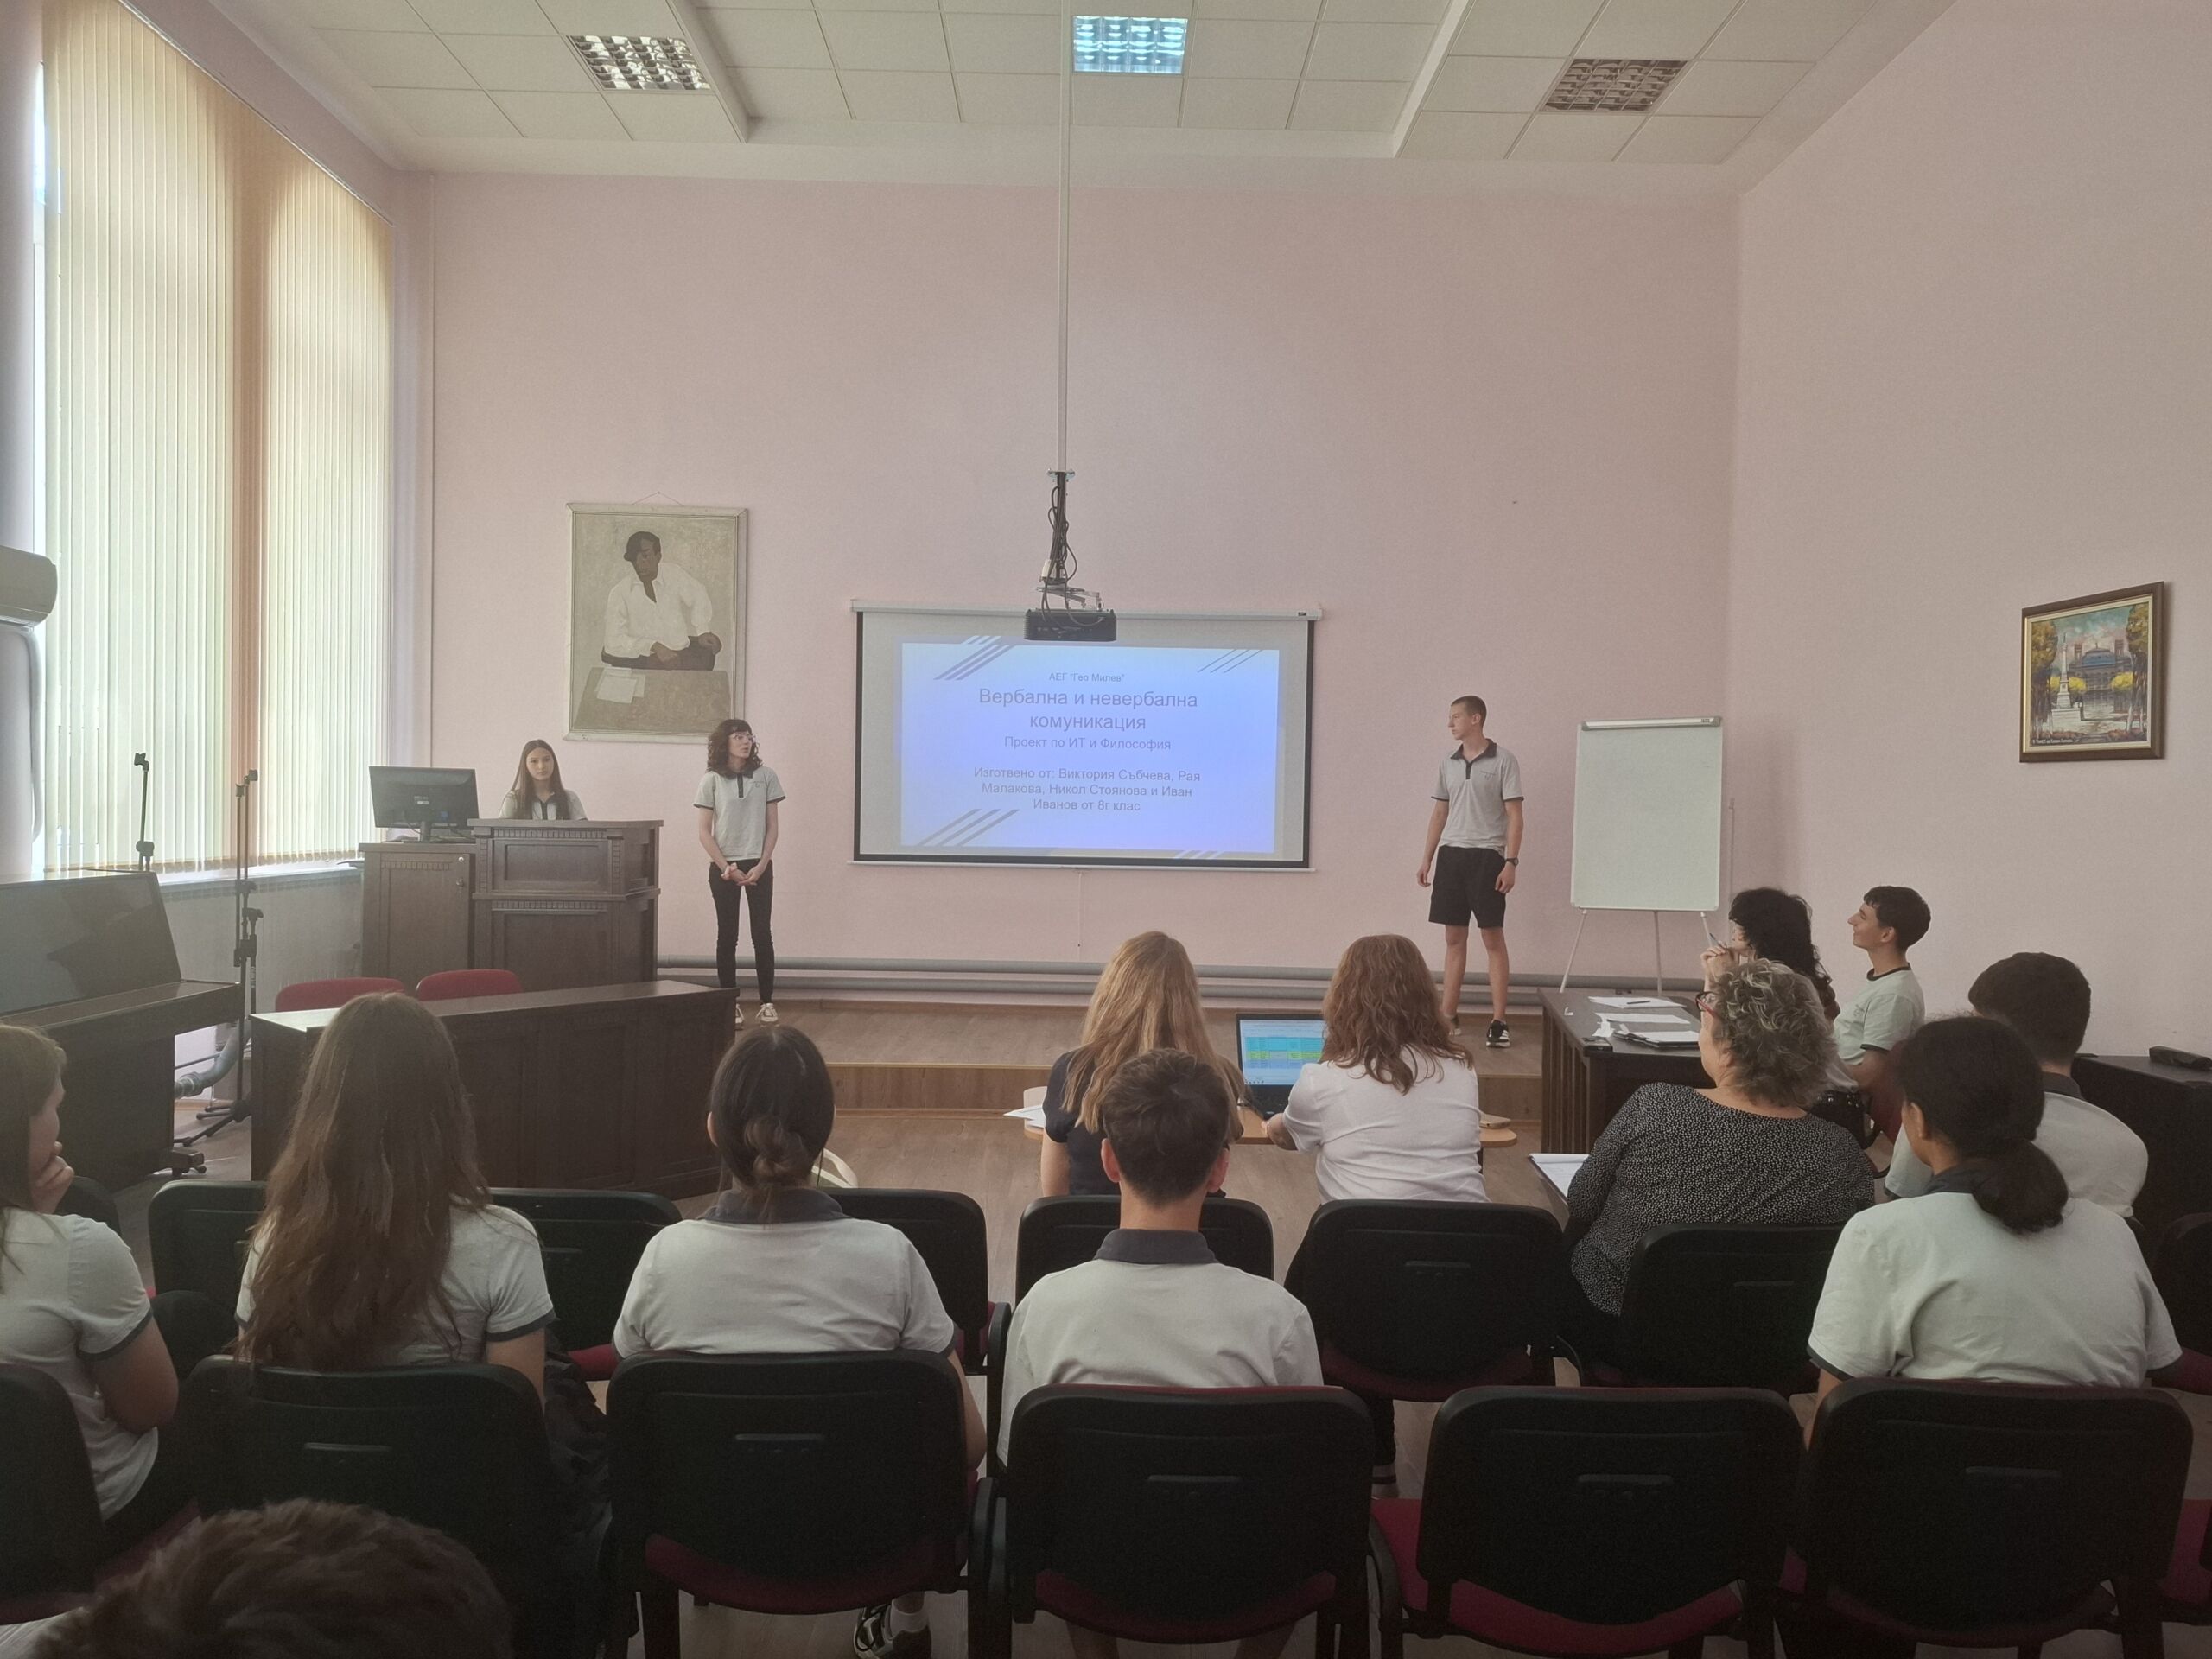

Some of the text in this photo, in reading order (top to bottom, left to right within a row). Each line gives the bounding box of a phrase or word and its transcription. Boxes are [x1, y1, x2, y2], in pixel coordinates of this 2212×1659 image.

[1048, 672, 1069, 682] АЕГ
[979, 688, 1198, 710] Вербална и невербална
[1030, 714, 1145, 733] комуникация
[1004, 735, 1172, 753] Проект по ИТ и Философия
[974, 766, 1200, 782] Изготвено от: Виктория Събчева, Рая
[982, 782, 1192, 798] Малакова, Никол Стоянова и Иван
[1033, 798, 1141, 811] Иванов от 8г клас
